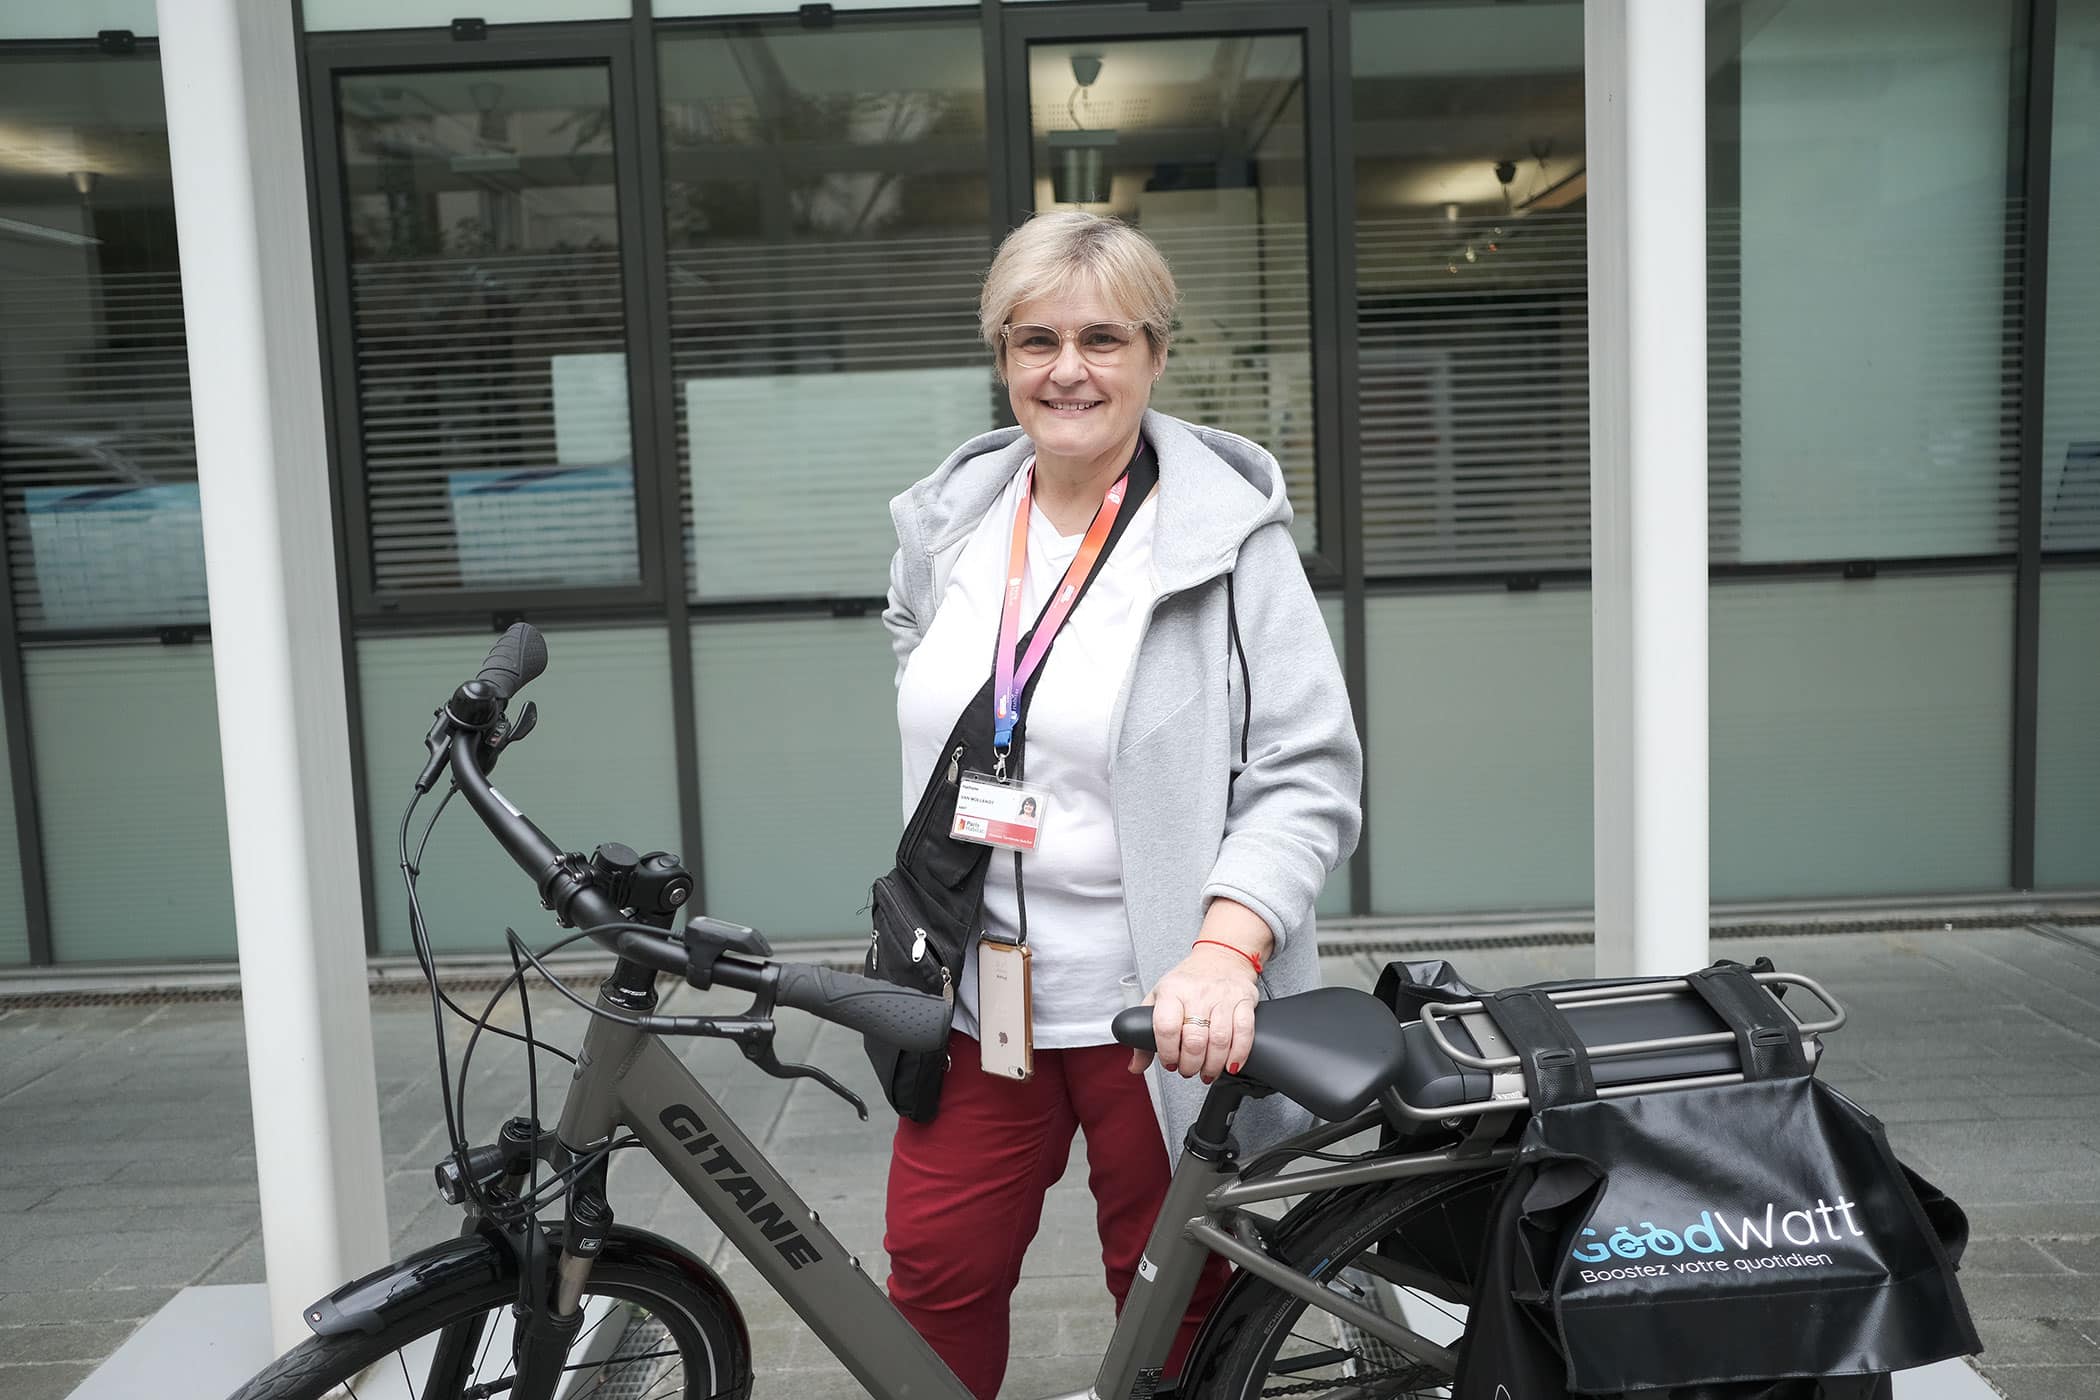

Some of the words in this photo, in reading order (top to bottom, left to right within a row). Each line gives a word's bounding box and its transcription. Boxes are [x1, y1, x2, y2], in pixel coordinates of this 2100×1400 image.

[659, 1104, 823, 1271] GITANE
[1580, 1264, 1669, 1283] Boostez
[1672, 1259, 1730, 1275] votre
[1734, 1252, 1833, 1273] quotidien
